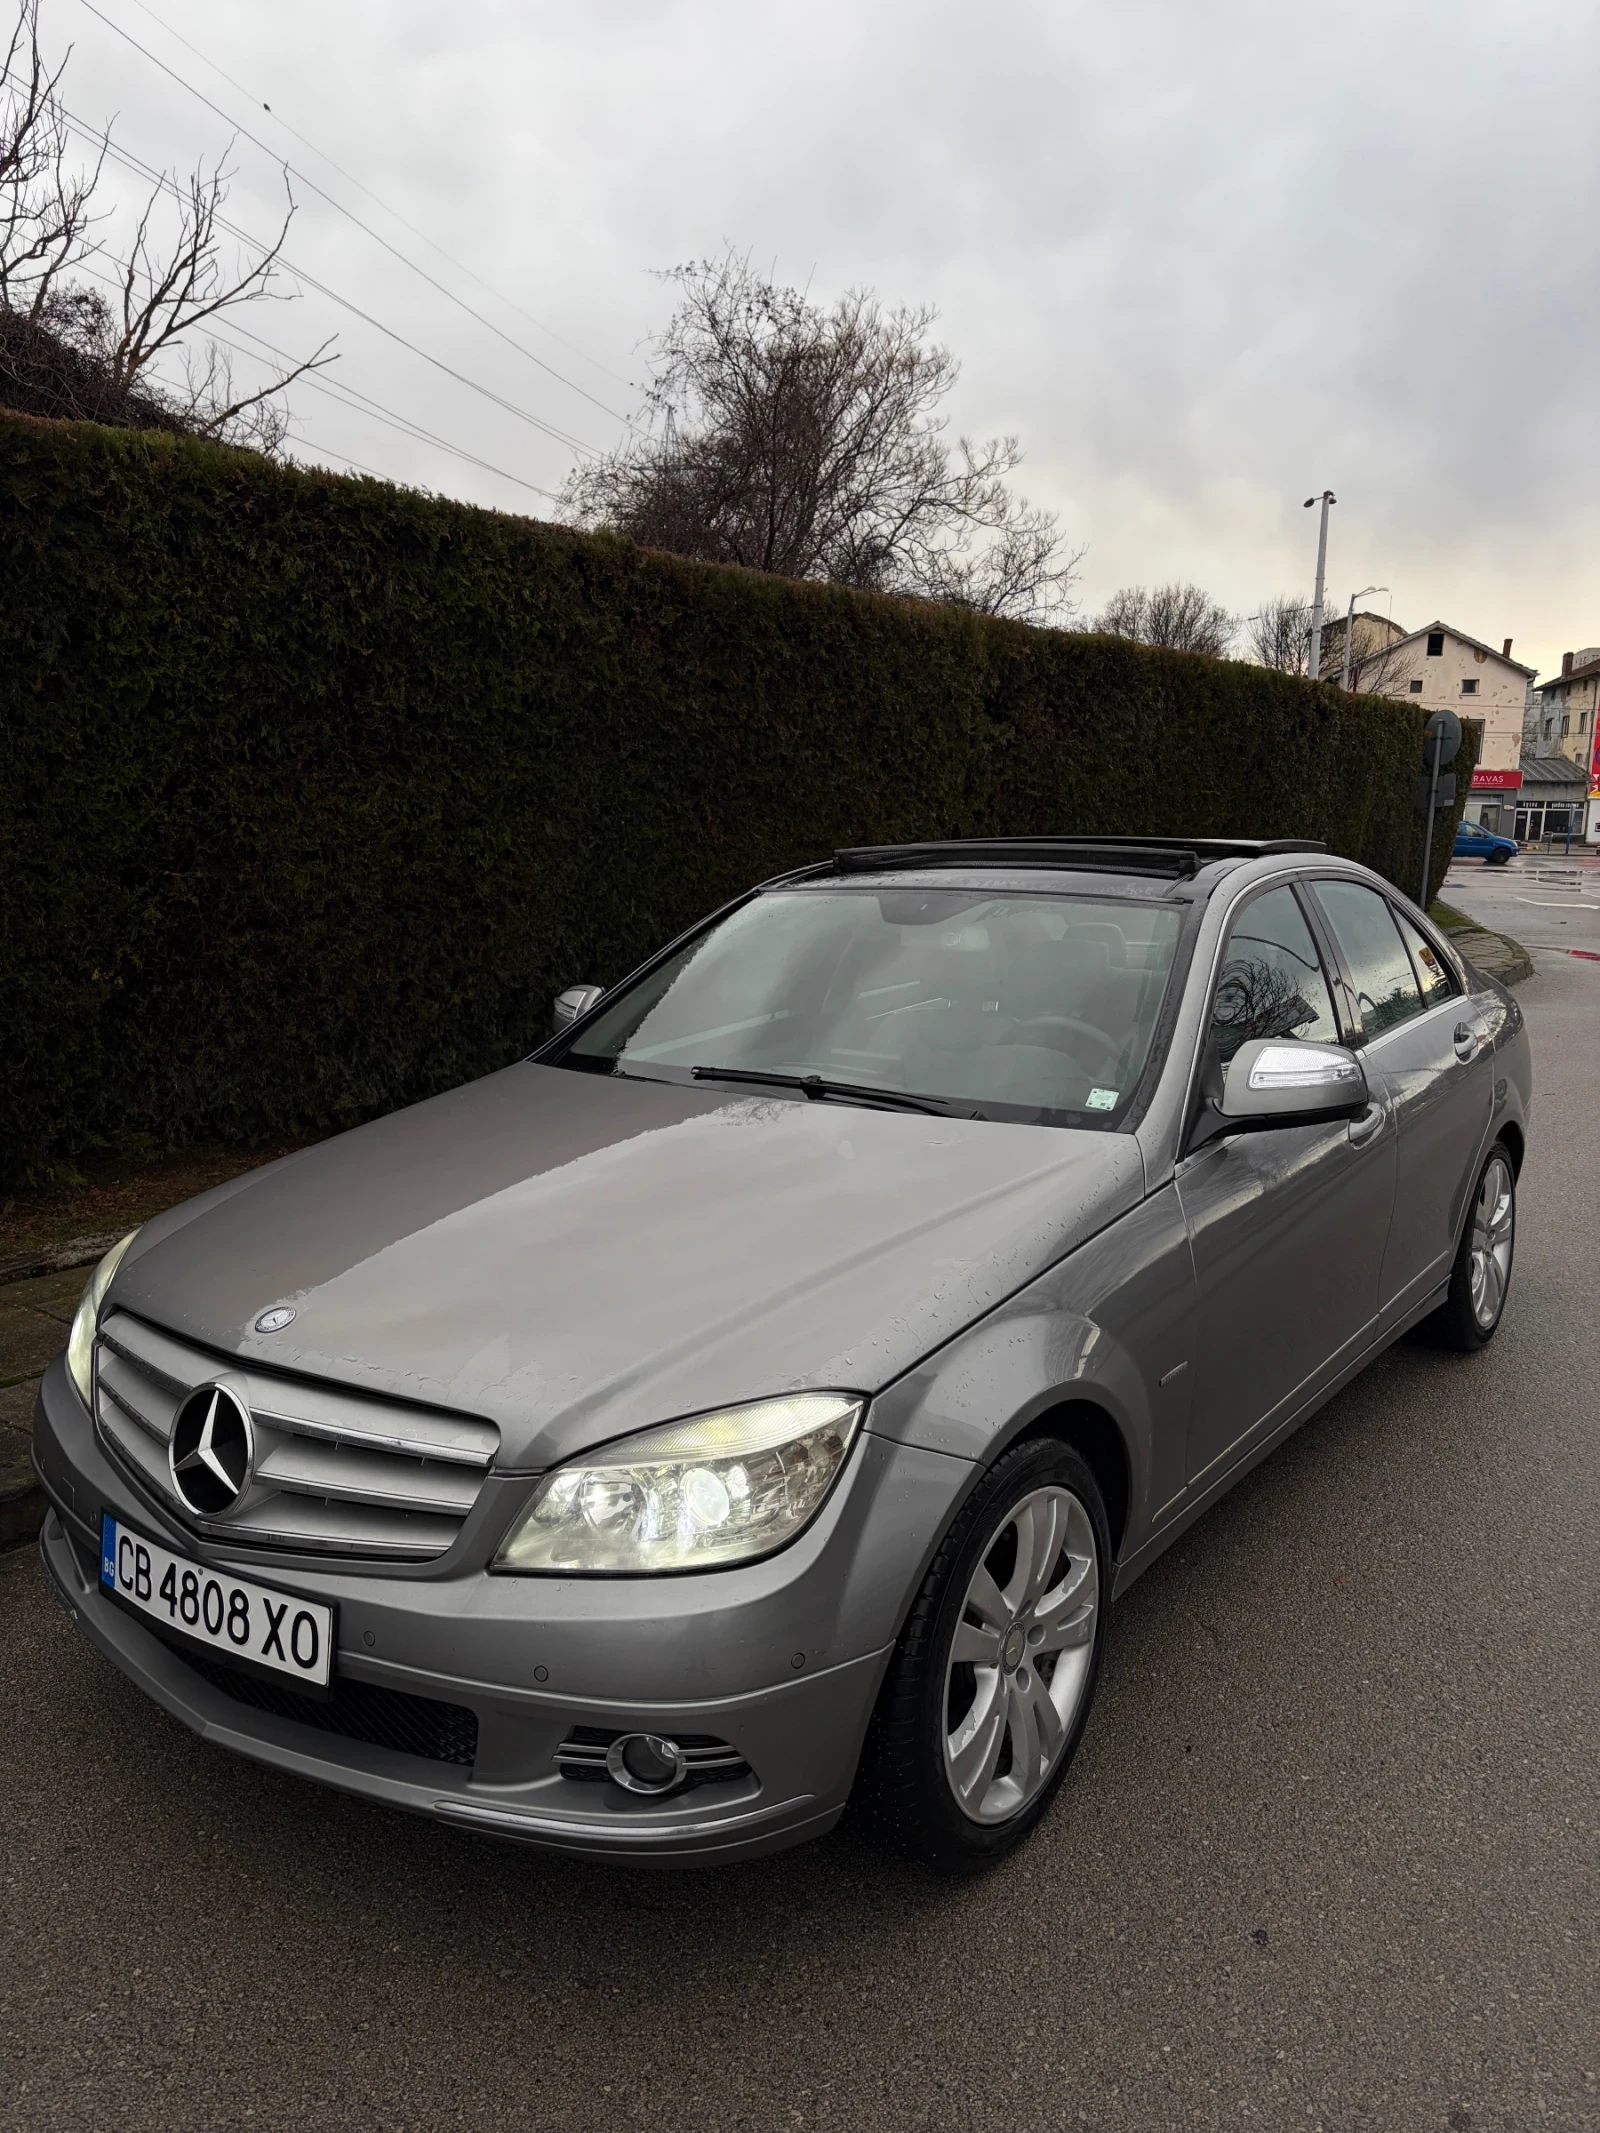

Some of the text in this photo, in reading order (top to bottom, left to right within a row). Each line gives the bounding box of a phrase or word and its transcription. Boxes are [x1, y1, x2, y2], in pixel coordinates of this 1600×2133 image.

[104, 1556, 115, 1577] BG
[118, 1535, 319, 1669] CB 4808 XO
